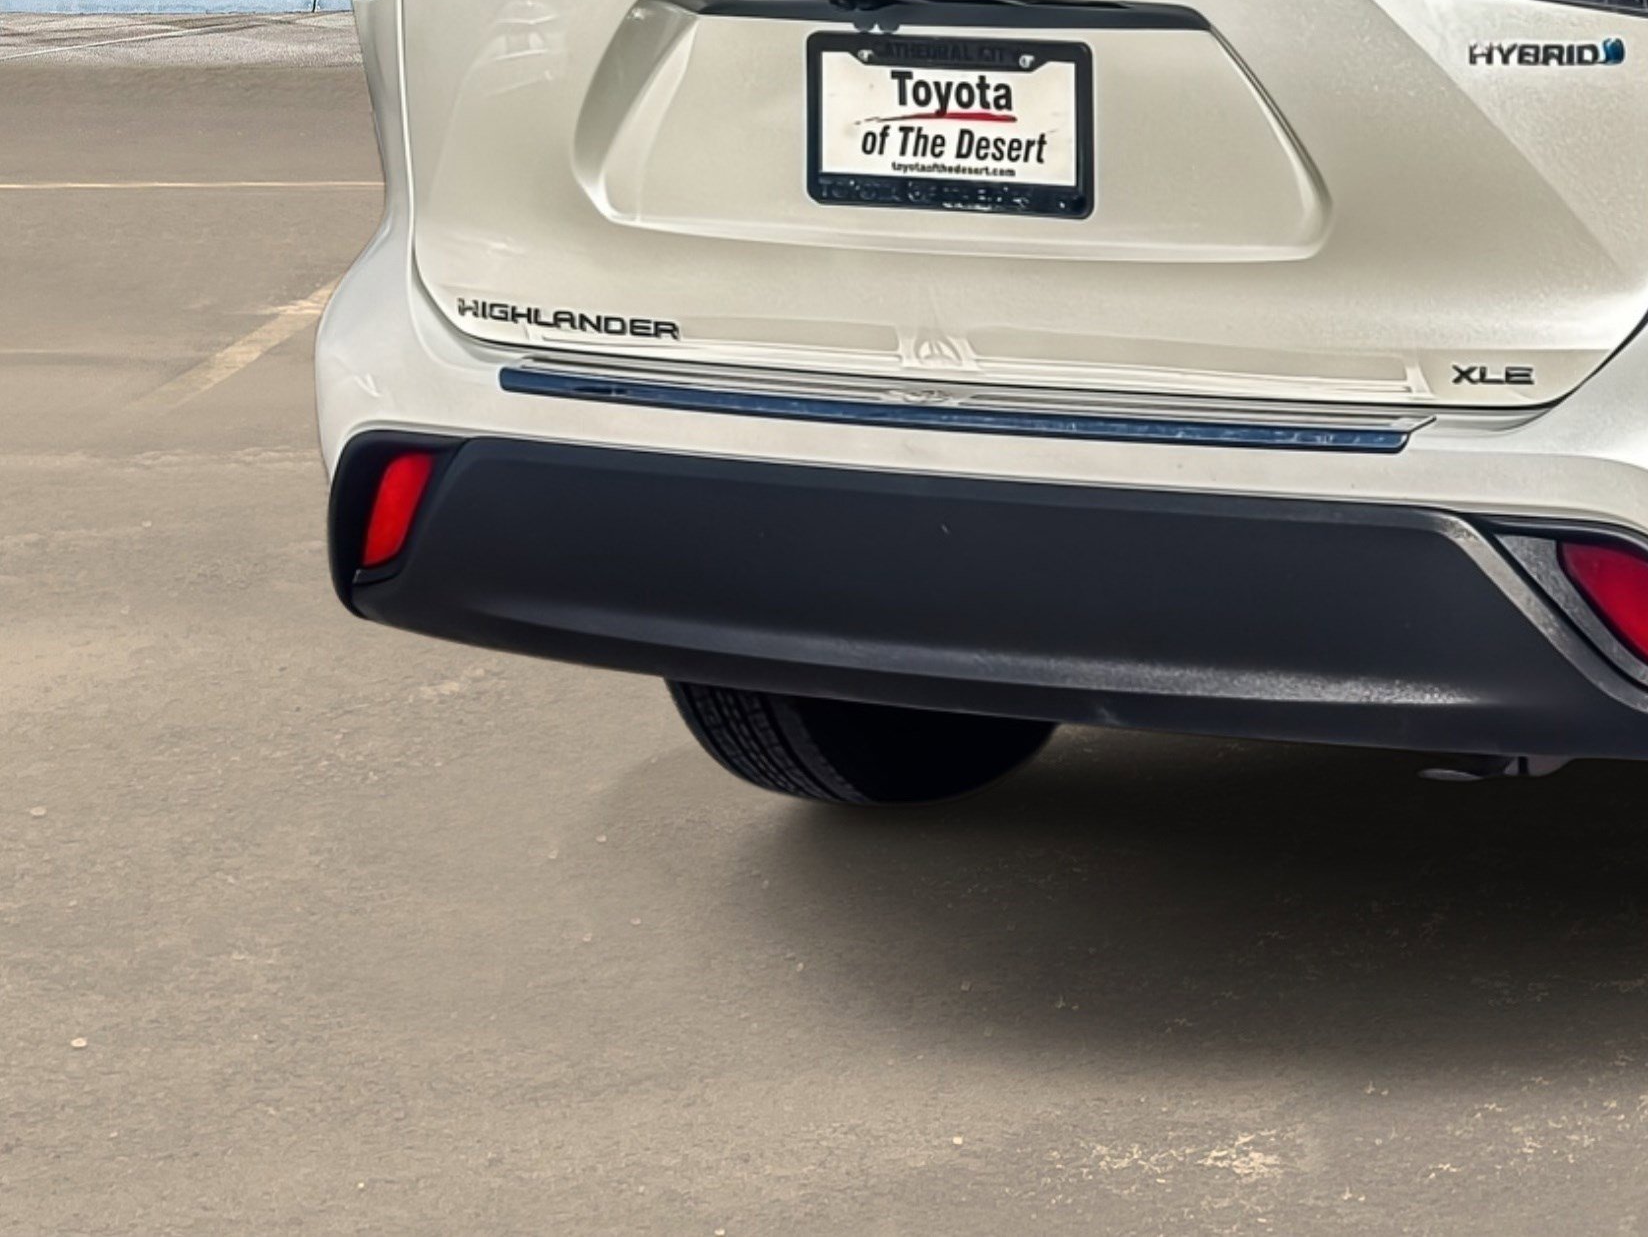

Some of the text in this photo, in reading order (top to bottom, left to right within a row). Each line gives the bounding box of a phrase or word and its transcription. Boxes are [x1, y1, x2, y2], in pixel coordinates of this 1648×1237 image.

[1469, 42, 1599, 66] HYBRID
[890, 69, 1013, 117] Toyota
[861, 125, 1047, 164] of The Desert
[891, 162, 1016, 177] toyotaofthedesert.com
[457, 297, 680, 341] HIGHLANDER
[1451, 364, 1535, 385] XLE
